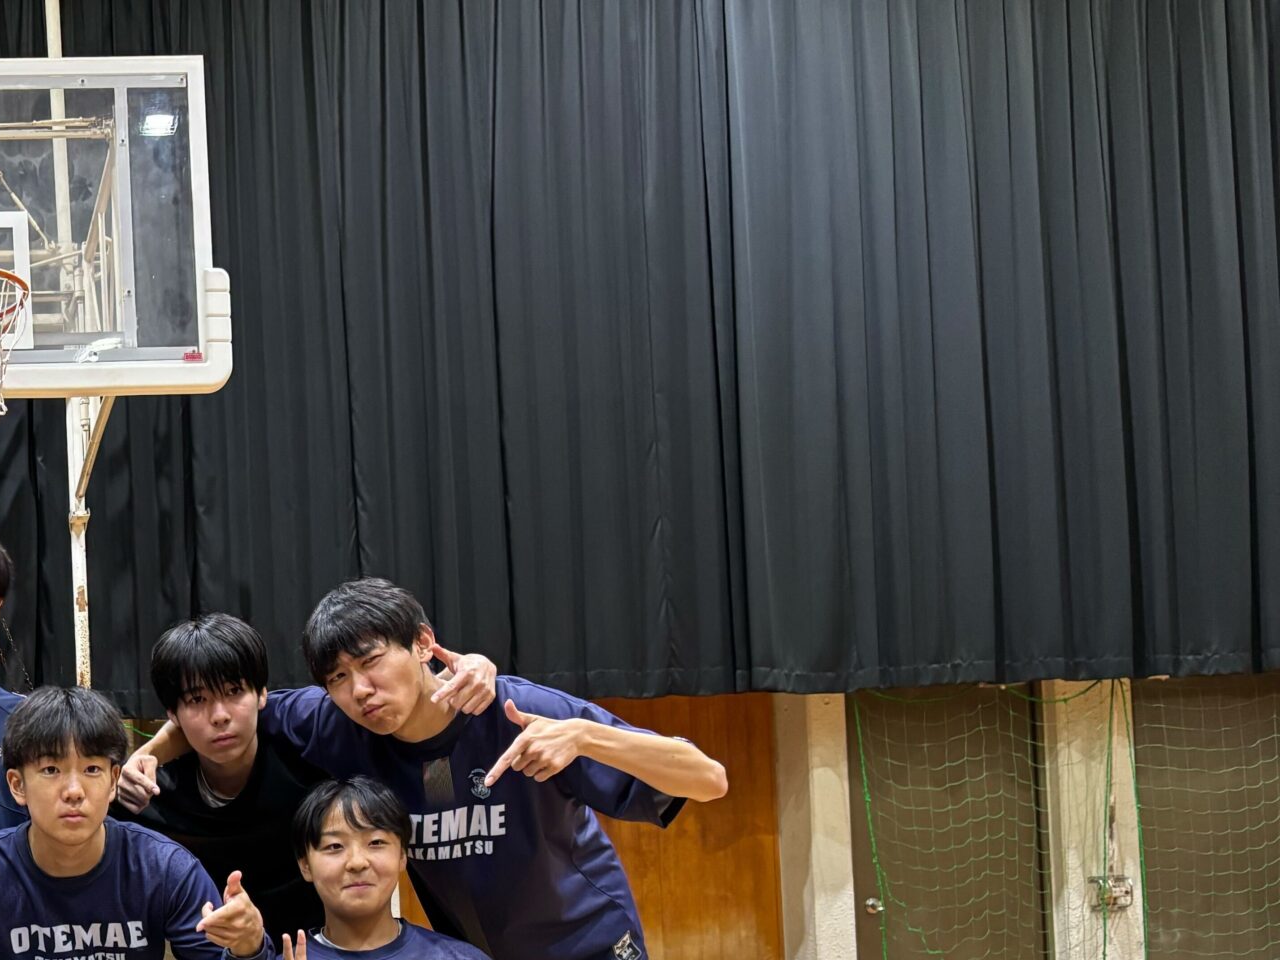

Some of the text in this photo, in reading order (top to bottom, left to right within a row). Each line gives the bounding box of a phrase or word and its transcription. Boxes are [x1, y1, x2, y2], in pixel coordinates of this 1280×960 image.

[409, 804, 506, 844] TEMAE
[408, 840, 493, 861] AKAMATSU
[10, 920, 148, 954] OTEMAE
